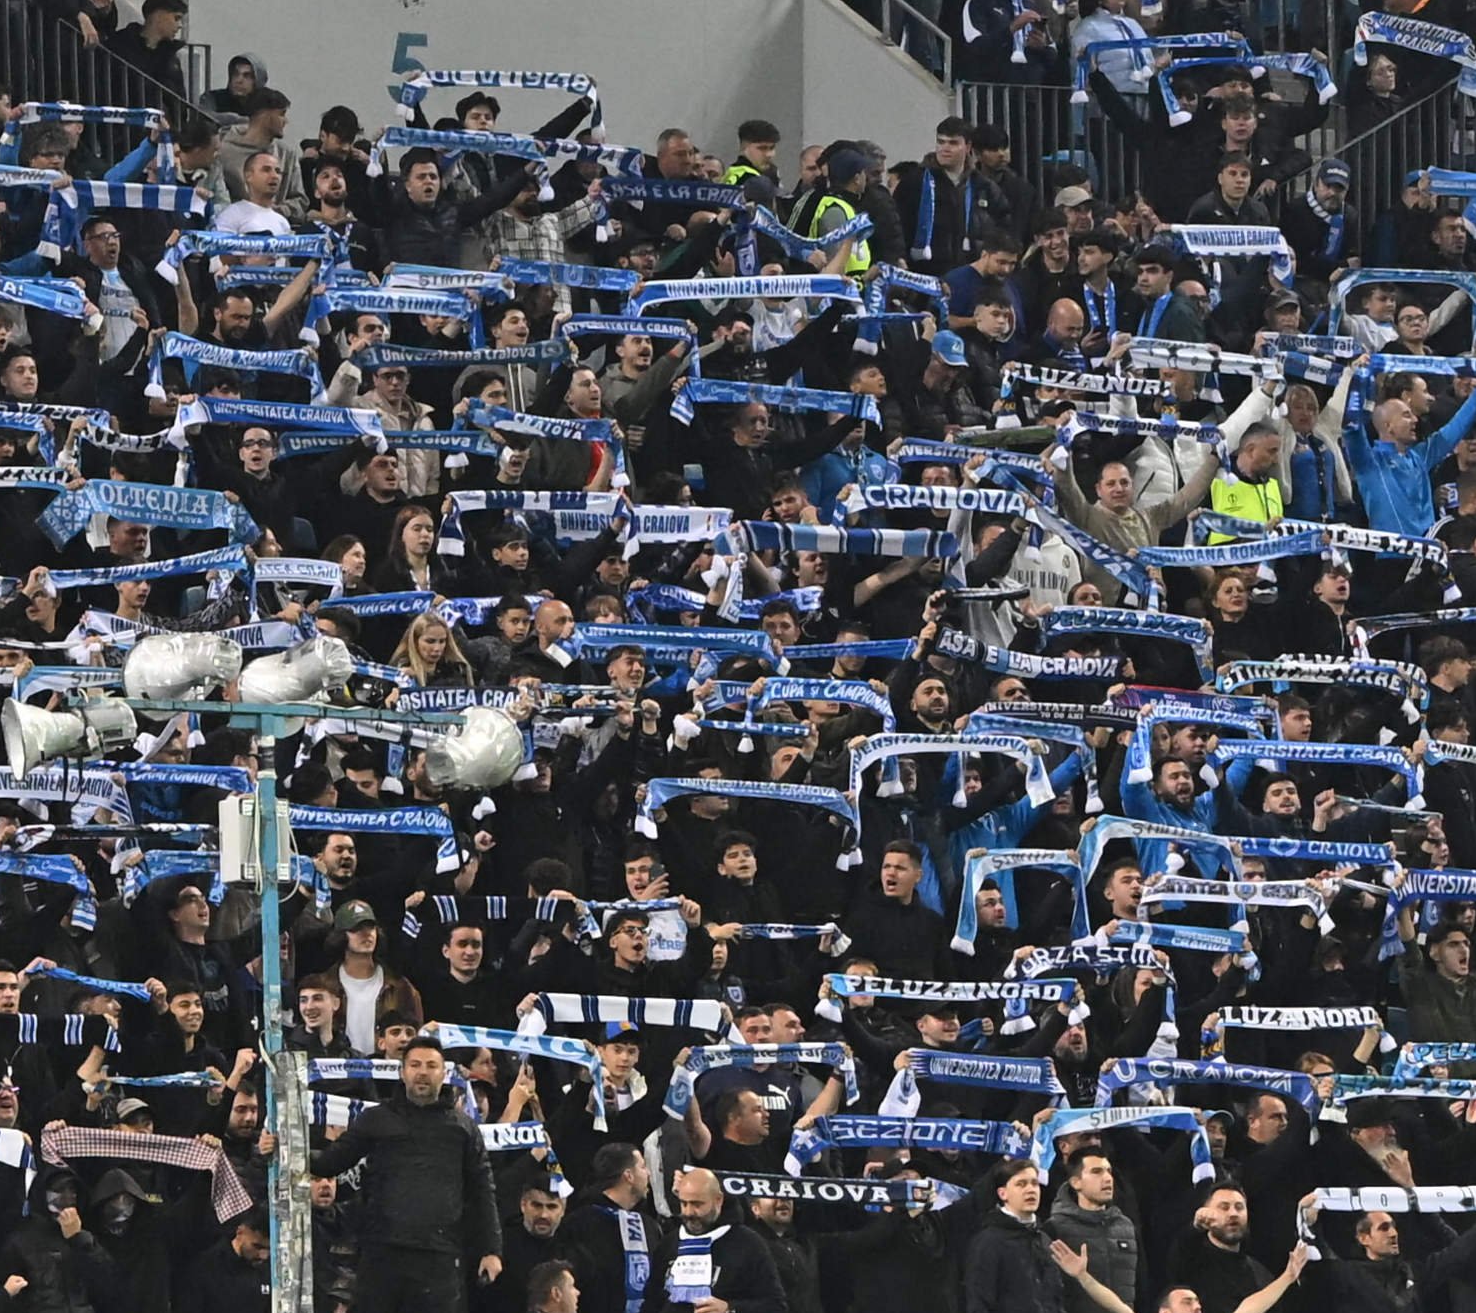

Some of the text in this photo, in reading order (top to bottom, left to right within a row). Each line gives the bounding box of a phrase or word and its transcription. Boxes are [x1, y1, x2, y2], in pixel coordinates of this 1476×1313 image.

[666, 278, 760, 296] UNIVERSITATEA
[864, 486, 1027, 516] CRAIOVA
[723, 1172, 891, 1205] CRAIOVA
